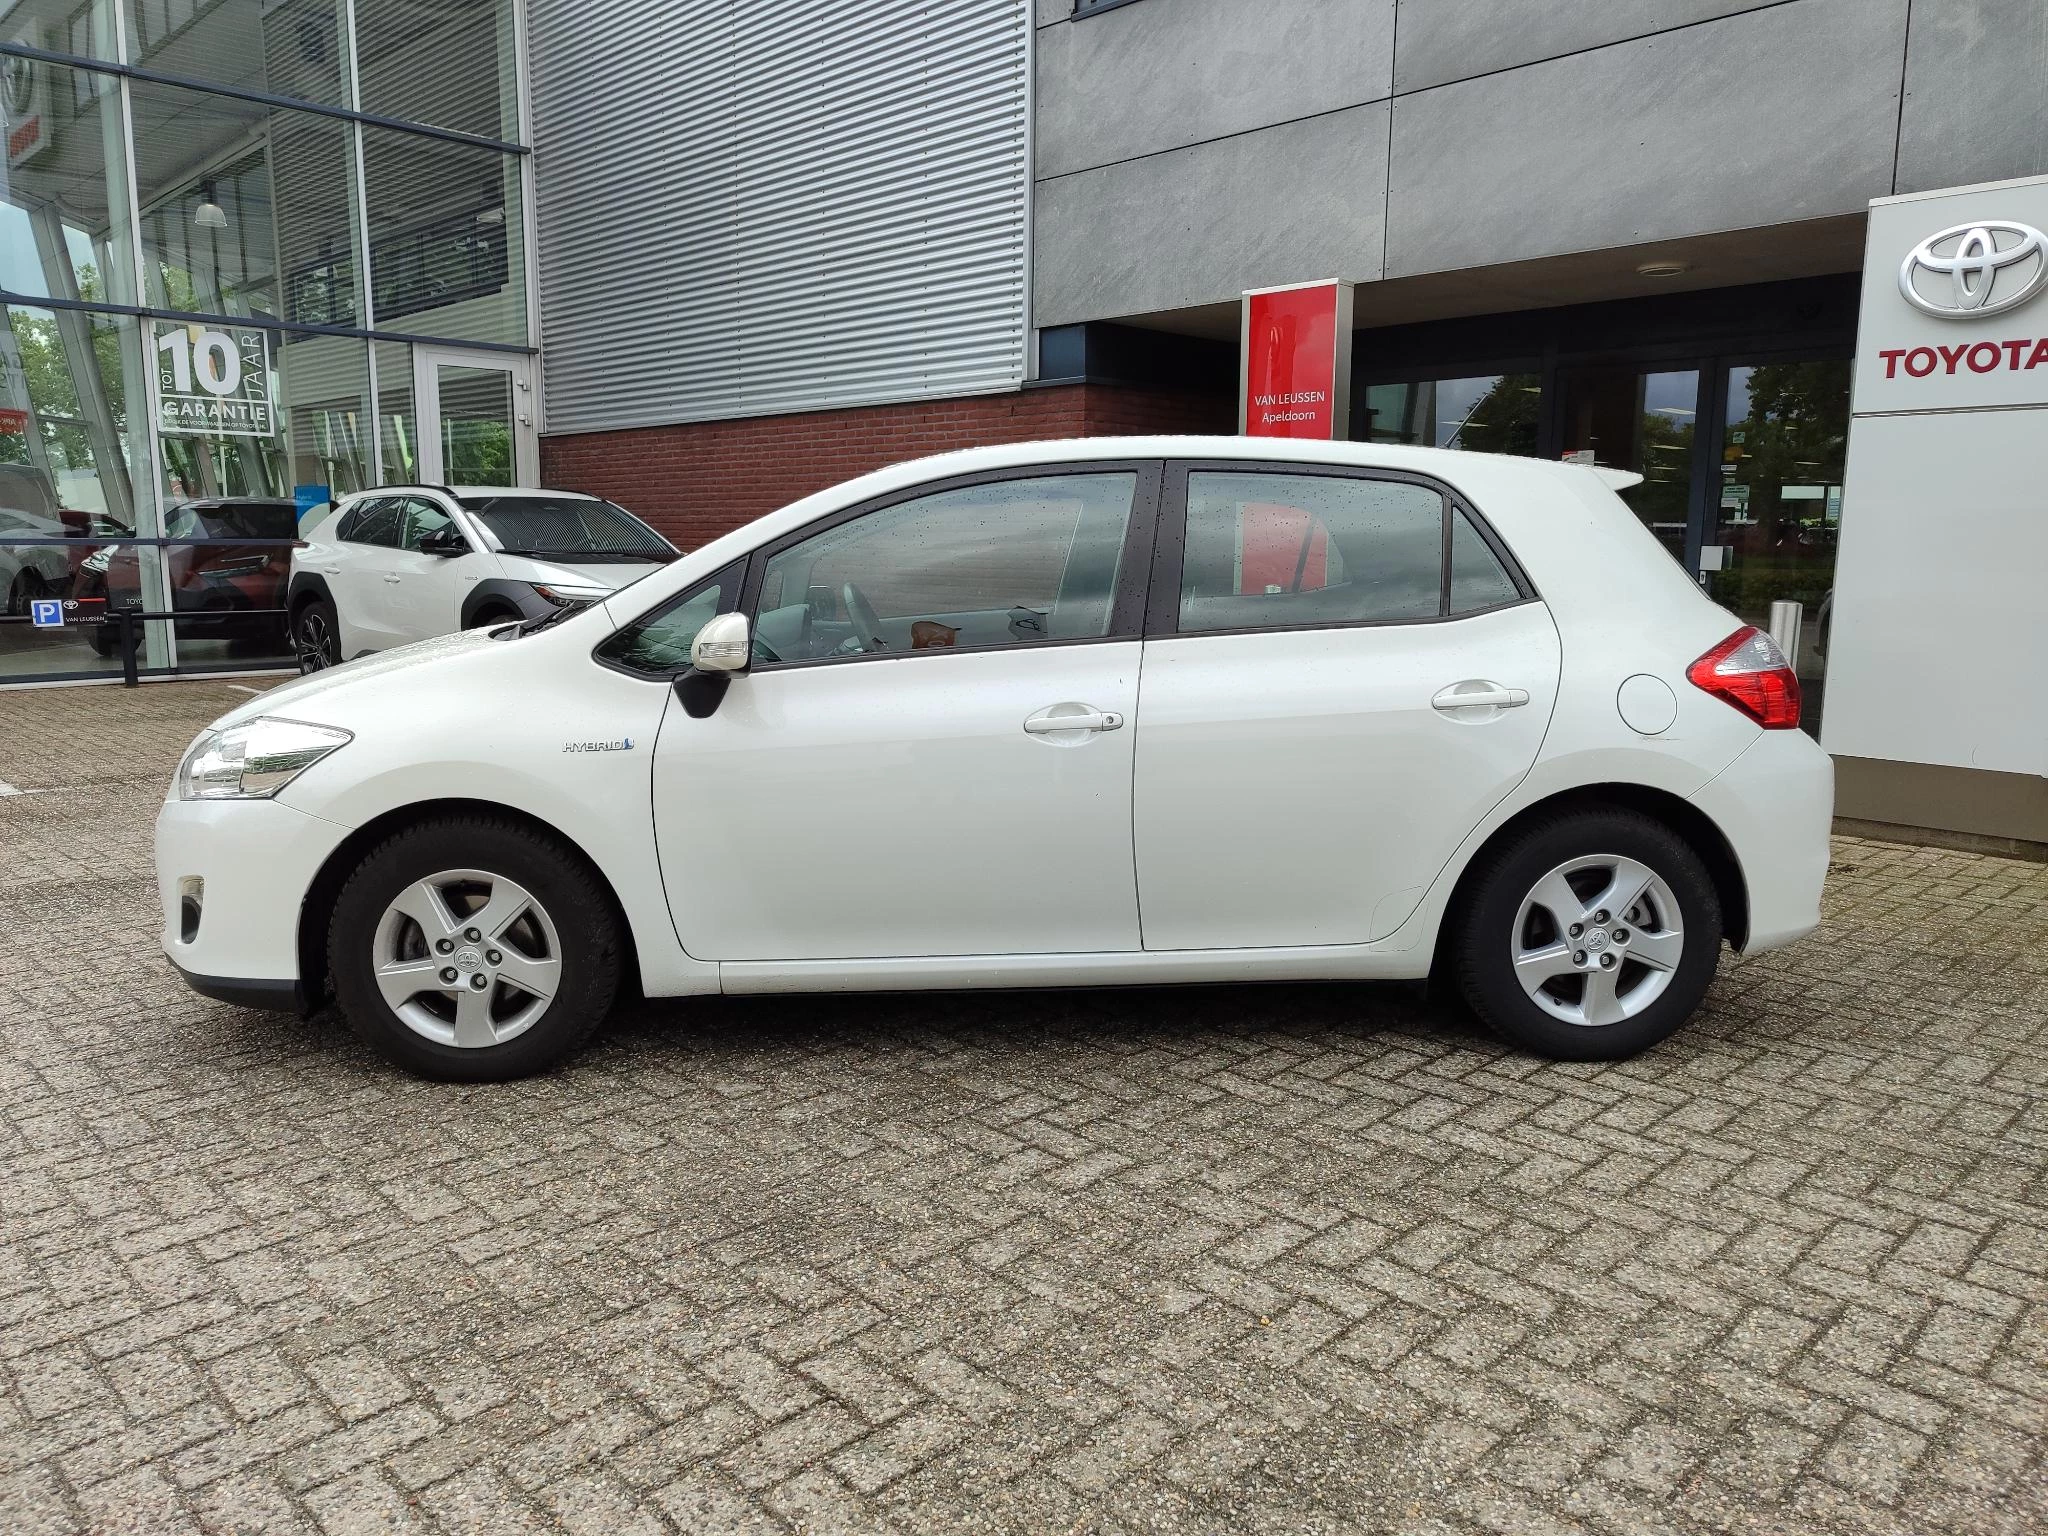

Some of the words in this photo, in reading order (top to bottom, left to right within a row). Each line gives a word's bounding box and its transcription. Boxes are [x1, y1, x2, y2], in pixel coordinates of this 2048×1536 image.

[159, 328, 241, 395] 10
[241, 335, 265, 398] JAAR
[1879, 338, 2048, 379] TOYOTA
[161, 368, 173, 391] TOT
[1254, 394, 1276, 406] VAN
[1278, 391, 1325, 405] LEUSSEN
[163, 401, 266, 421] GARANTIE
[1262, 410, 1316, 425] Apeldoorn
[38, 603, 55, 623] P
[562, 740, 624, 753] HYBRID
